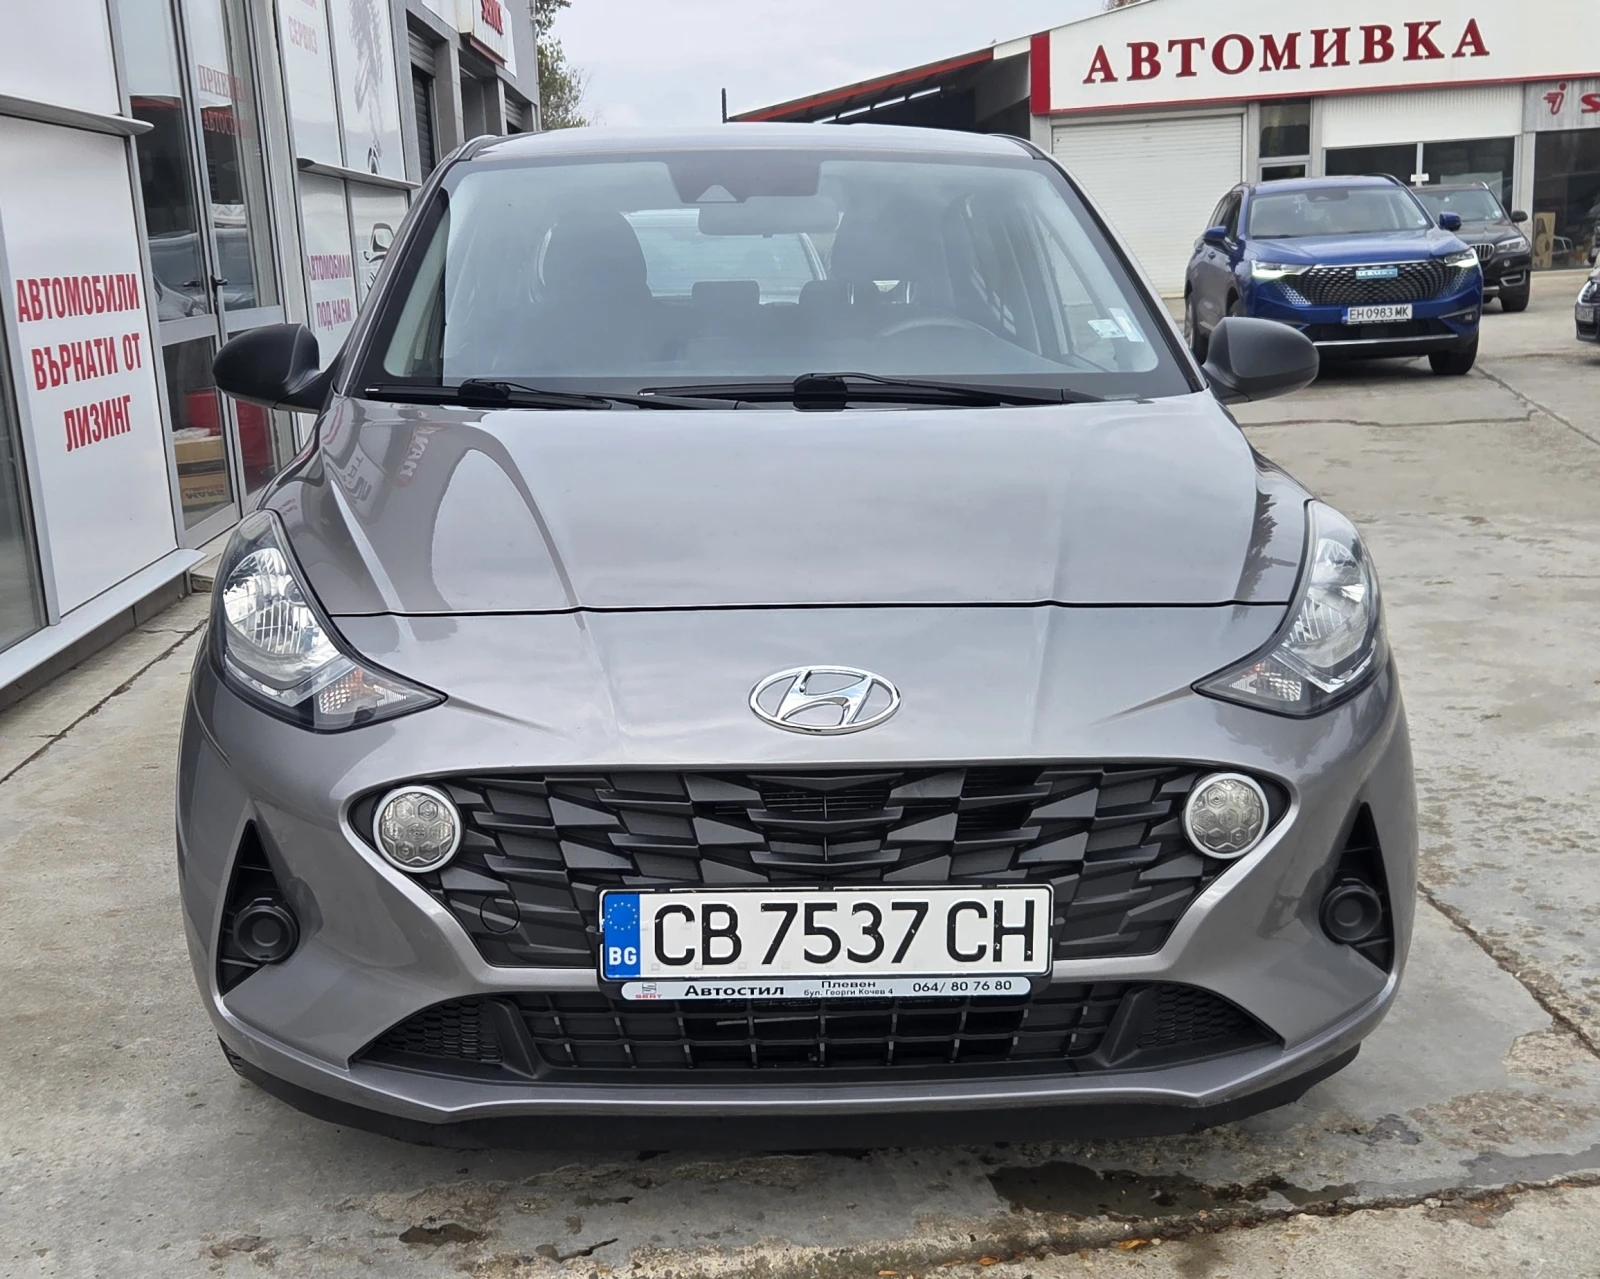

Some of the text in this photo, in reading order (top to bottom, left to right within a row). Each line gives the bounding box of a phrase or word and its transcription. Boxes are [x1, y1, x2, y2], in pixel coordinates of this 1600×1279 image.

[1082, 17, 1490, 85] АВТОМИВКА
[16, 273, 140, 322] АВТОМОБИЛИ
[1349, 308, 1365, 320] EH
[1366, 307, 1393, 319] 0983
[1395, 306, 1409, 317] MK
[31, 333, 141, 391] ВЪРНАТИ ОТ
[63, 394, 131, 452] ЛИЗИНГ
[609, 898, 1035, 966] BG CB 7537 CH
[684, 984, 784, 997] Автостил
[821, 980, 876, 988] Плевен
[825, 988, 856, 997] Георги
[887, 987, 893, 995] 4
[912, 980, 1012, 993] 064/ 80 76 80
